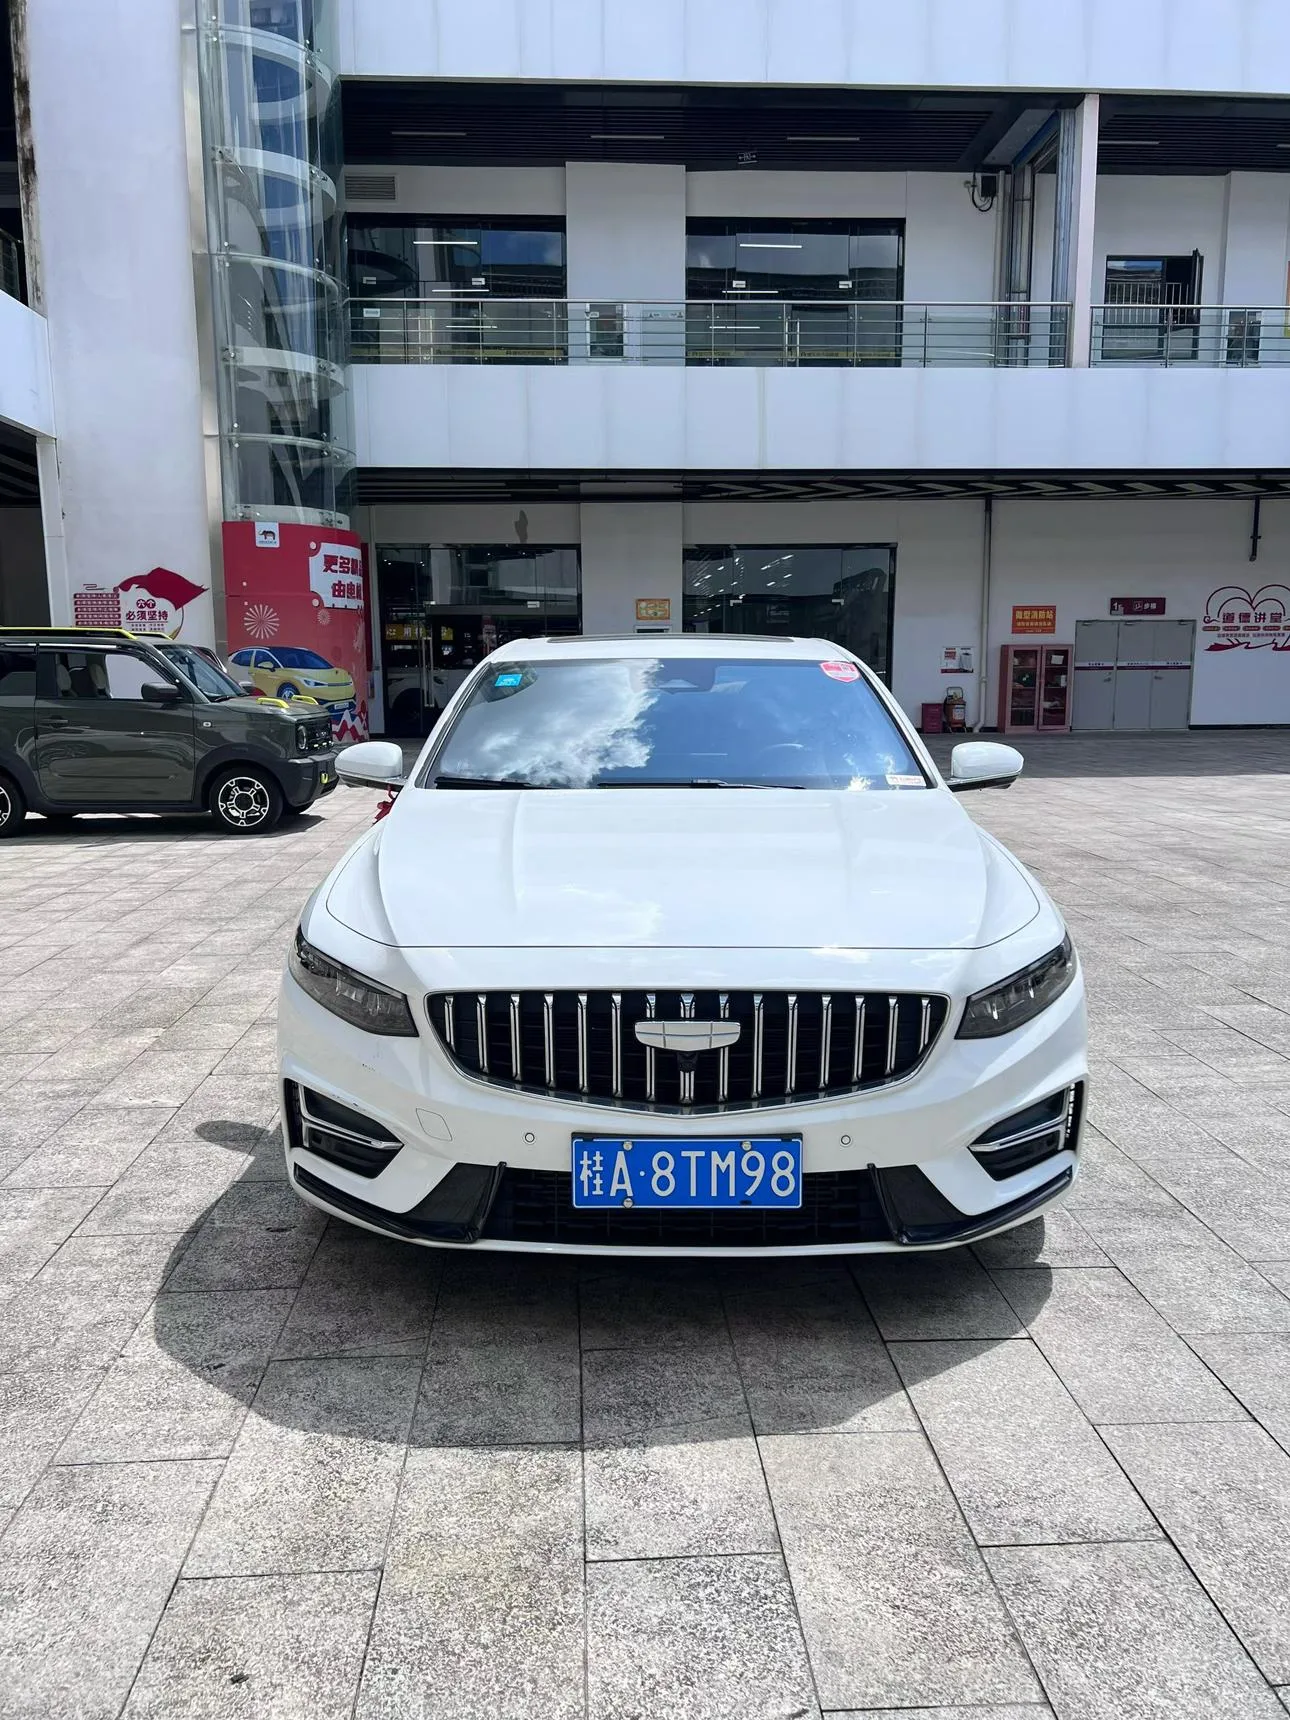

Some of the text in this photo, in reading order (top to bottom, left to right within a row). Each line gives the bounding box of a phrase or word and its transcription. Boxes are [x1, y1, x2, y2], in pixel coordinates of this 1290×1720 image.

[136, 599, 156, 609] 六个
[126, 610, 169, 621] 必须坚持
[1222, 612, 1282, 623] 道德讲堂
